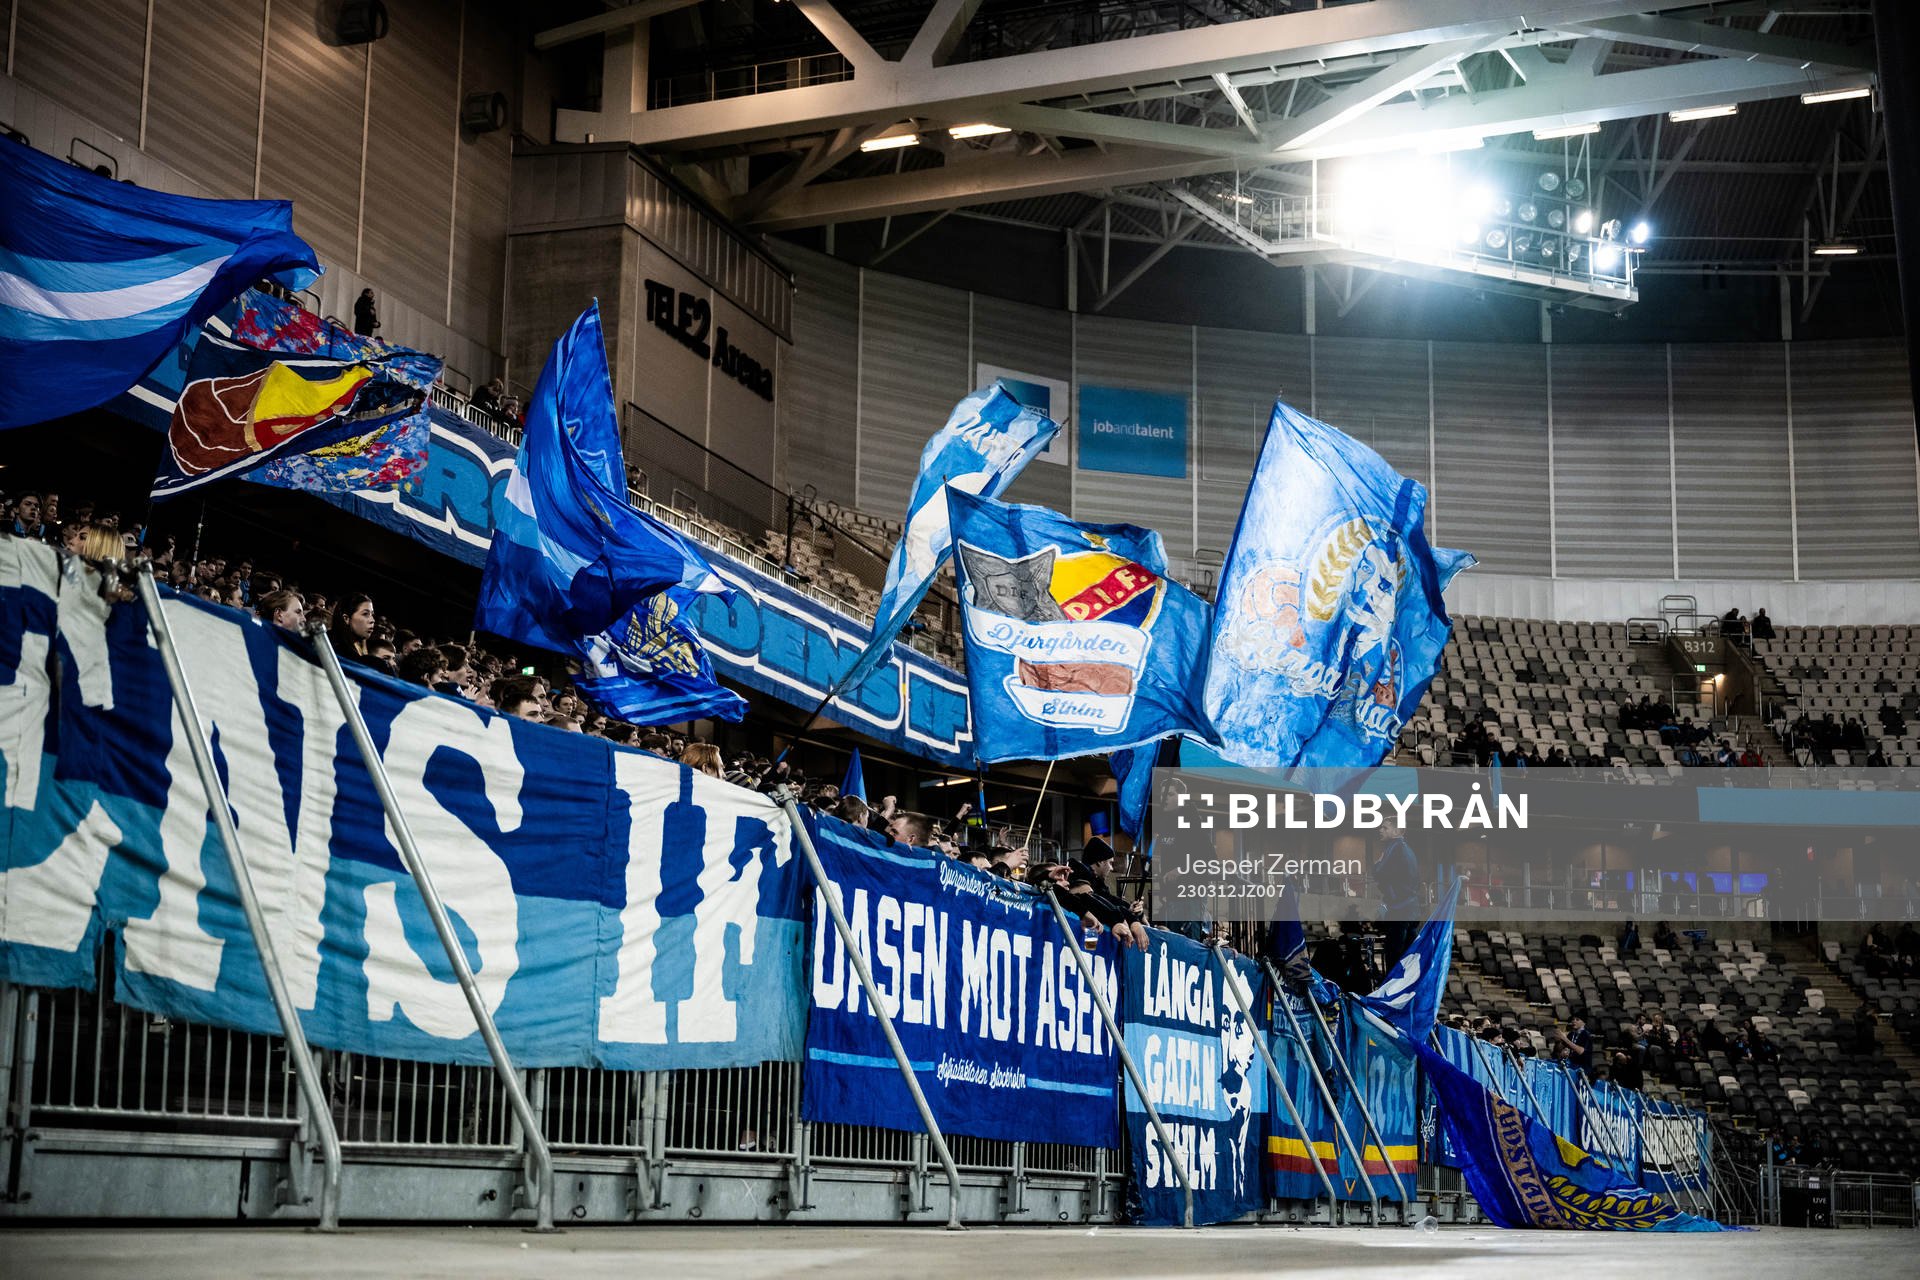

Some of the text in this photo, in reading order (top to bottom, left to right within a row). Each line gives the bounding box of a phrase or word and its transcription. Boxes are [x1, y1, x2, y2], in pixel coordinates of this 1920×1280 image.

[644, 279, 774, 402] TELE2 Arena
[1093, 419, 1174, 439] jobandtalent
[986, 622, 1129, 656] Djurgården
[1684, 640, 1715, 653] B312
[597, 750, 793, 1044] IF
[960, 920, 1032, 1044] MOT
[1035, 941, 1118, 1057] ASEN
[1143, 942, 1216, 1028] LÅNGA
[989, 1061, 1026, 1090] Stockholm
[1144, 1034, 1216, 1111] GATAN
[1145, 1121, 1217, 1191] STHLM
